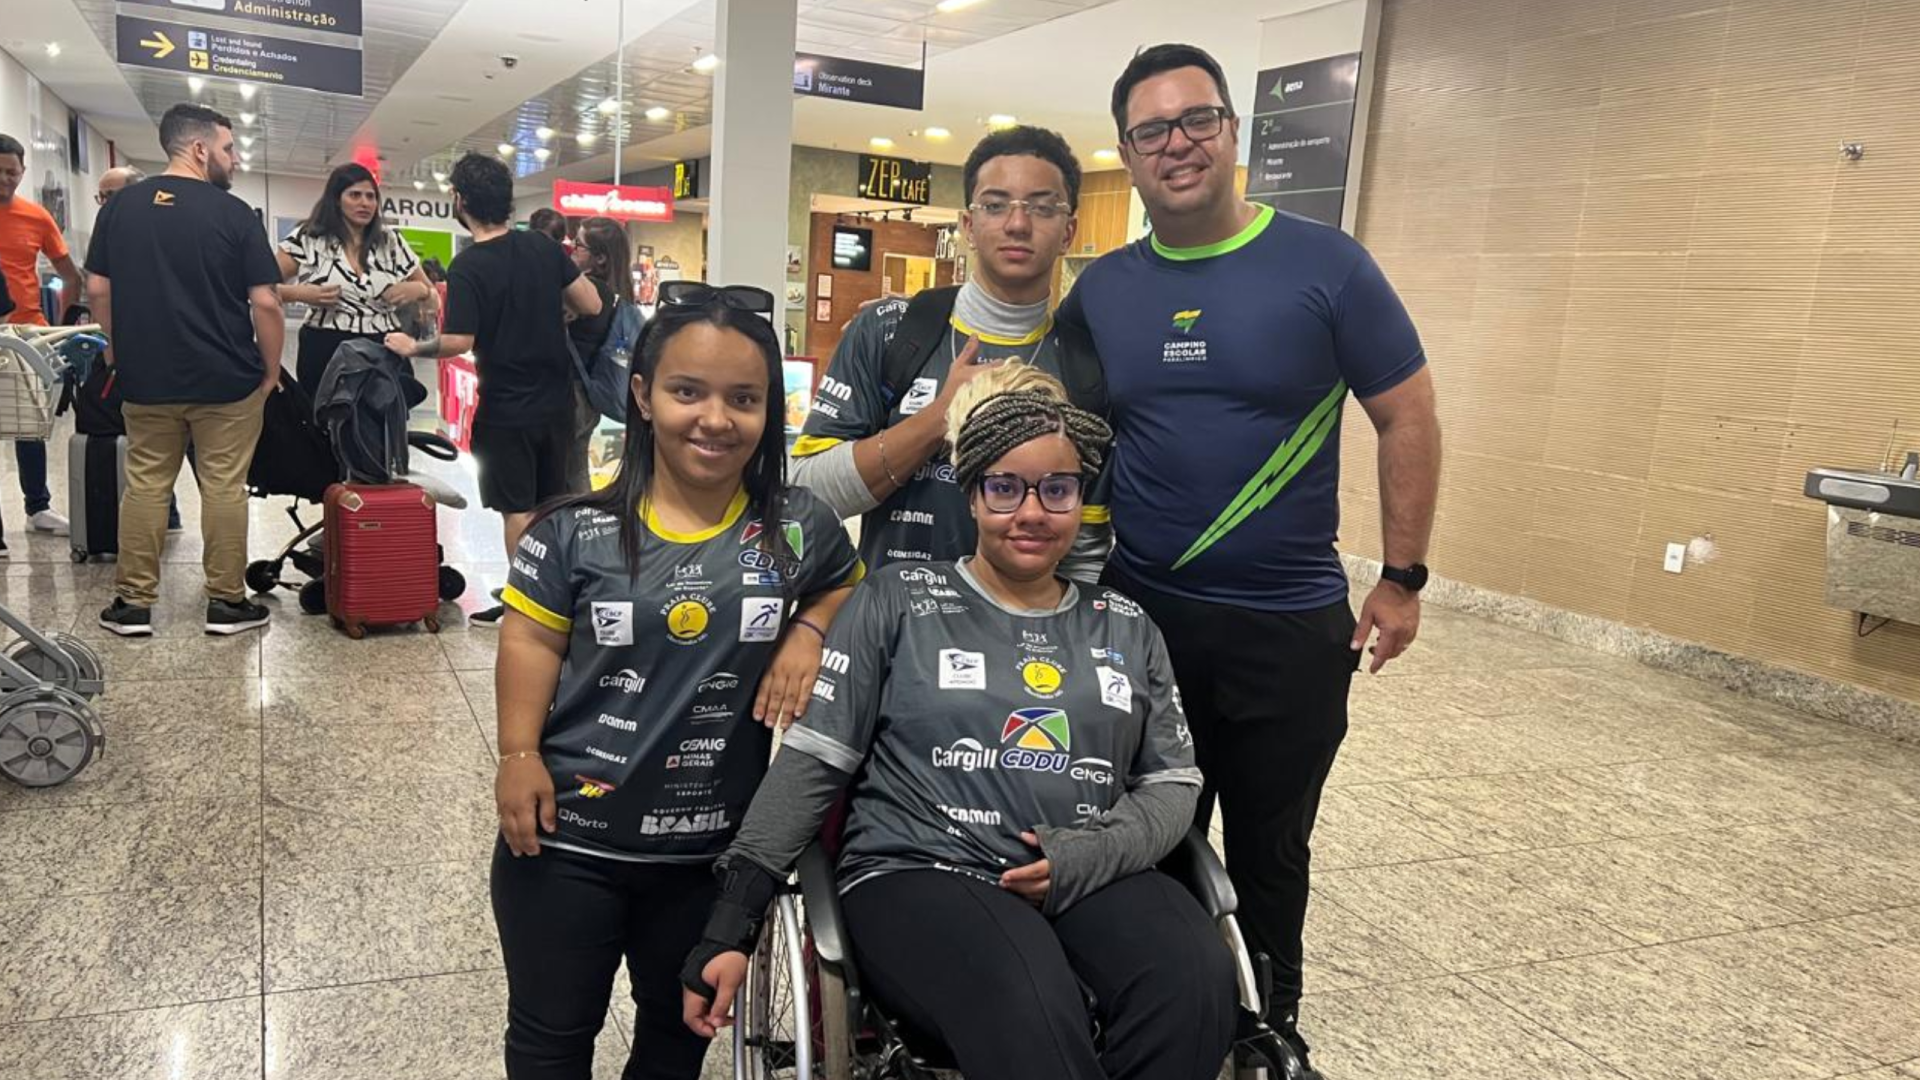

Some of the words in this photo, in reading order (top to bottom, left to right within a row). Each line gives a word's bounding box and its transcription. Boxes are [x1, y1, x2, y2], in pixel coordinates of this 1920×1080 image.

[234, 1, 337, 26] Administração
[211, 43, 250, 56] Perdidos
[260, 50, 298, 62] Achados
[866, 157, 900, 199] ZEP
[900, 570, 948, 585] Cargill
[660, 594, 687, 616] PRAIA
[600, 674, 646, 694] Cargill
[680, 738, 726, 752] CEMIG
[932, 746, 998, 772] Cargill
[1001, 748, 1069, 774] CDDU
[569, 812, 608, 830] Porto
[640, 810, 730, 835] BRASIL
